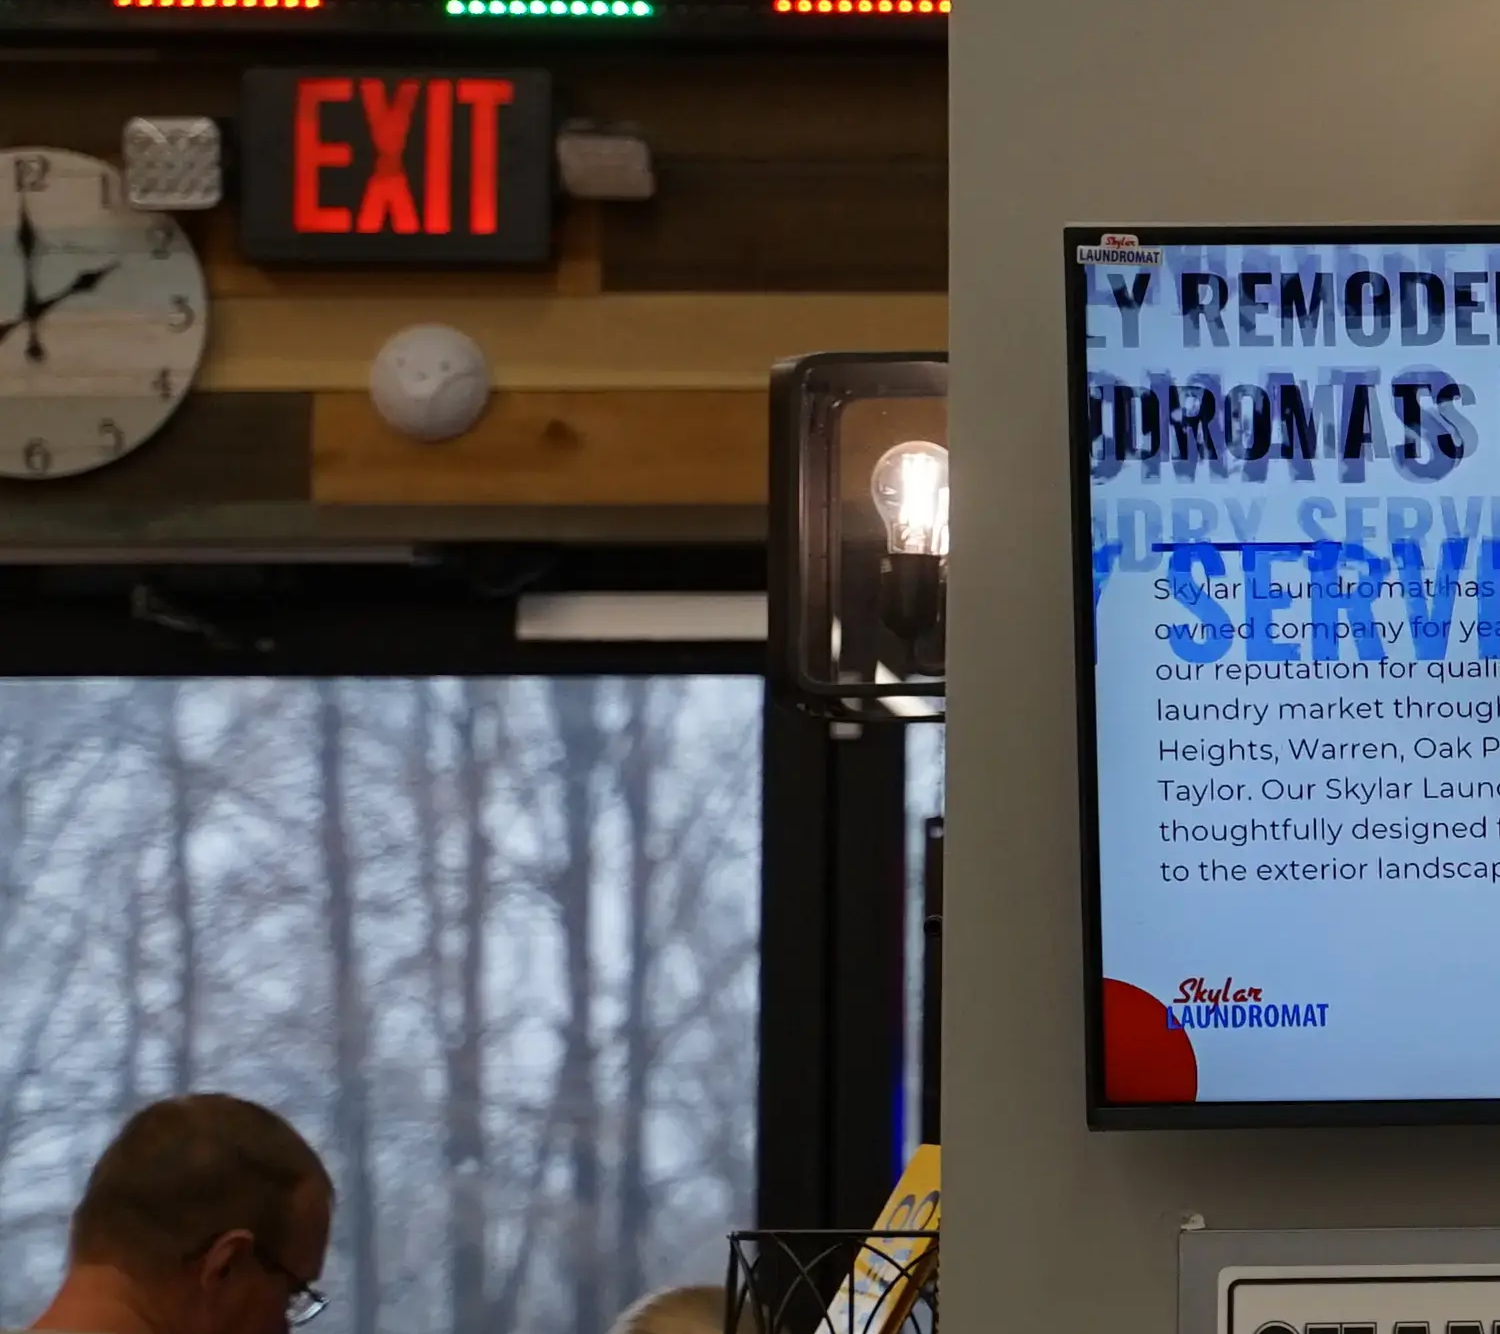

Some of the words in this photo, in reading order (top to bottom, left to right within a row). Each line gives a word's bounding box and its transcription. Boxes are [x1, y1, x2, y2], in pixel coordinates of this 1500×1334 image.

[292, 78, 514, 235] EXIT
[13, 156, 51, 194] 12
[1078, 249, 1161, 265] LAUNDROMAT
[1154, 577, 1241, 605] Skylar
[1251, 576, 1441, 600] Laundromat
[1446, 575, 1495, 598] has
[1154, 617, 1255, 641] owned
[1264, 620, 1405, 644] company
[1412, 615, 1451, 638] for
[1155, 662, 1204, 681] our
[1215, 657, 1369, 687] reputation
[1378, 656, 1418, 680] for
[1157, 697, 1269, 726] laundry
[1279, 697, 1384, 720] market
[1159, 738, 1279, 766] Heights,
[1288, 739, 1404, 763] Warren,
[1413, 737, 1473, 759] Oak
[1158, 778, 1252, 807] Taylor.
[1261, 779, 1317, 800] Our
[1326, 776, 1413, 805] Skylar
[1159, 817, 1343, 847] thoughtfully
[1351, 816, 1487, 845] designed
[1159, 862, 1190, 883] to
[1198, 858, 1247, 882] the
[1257, 858, 1369, 881] exterior
[1173, 976, 1264, 1010] Skylar
[1166, 1001, 1330, 1030] LAUNDROMAT
